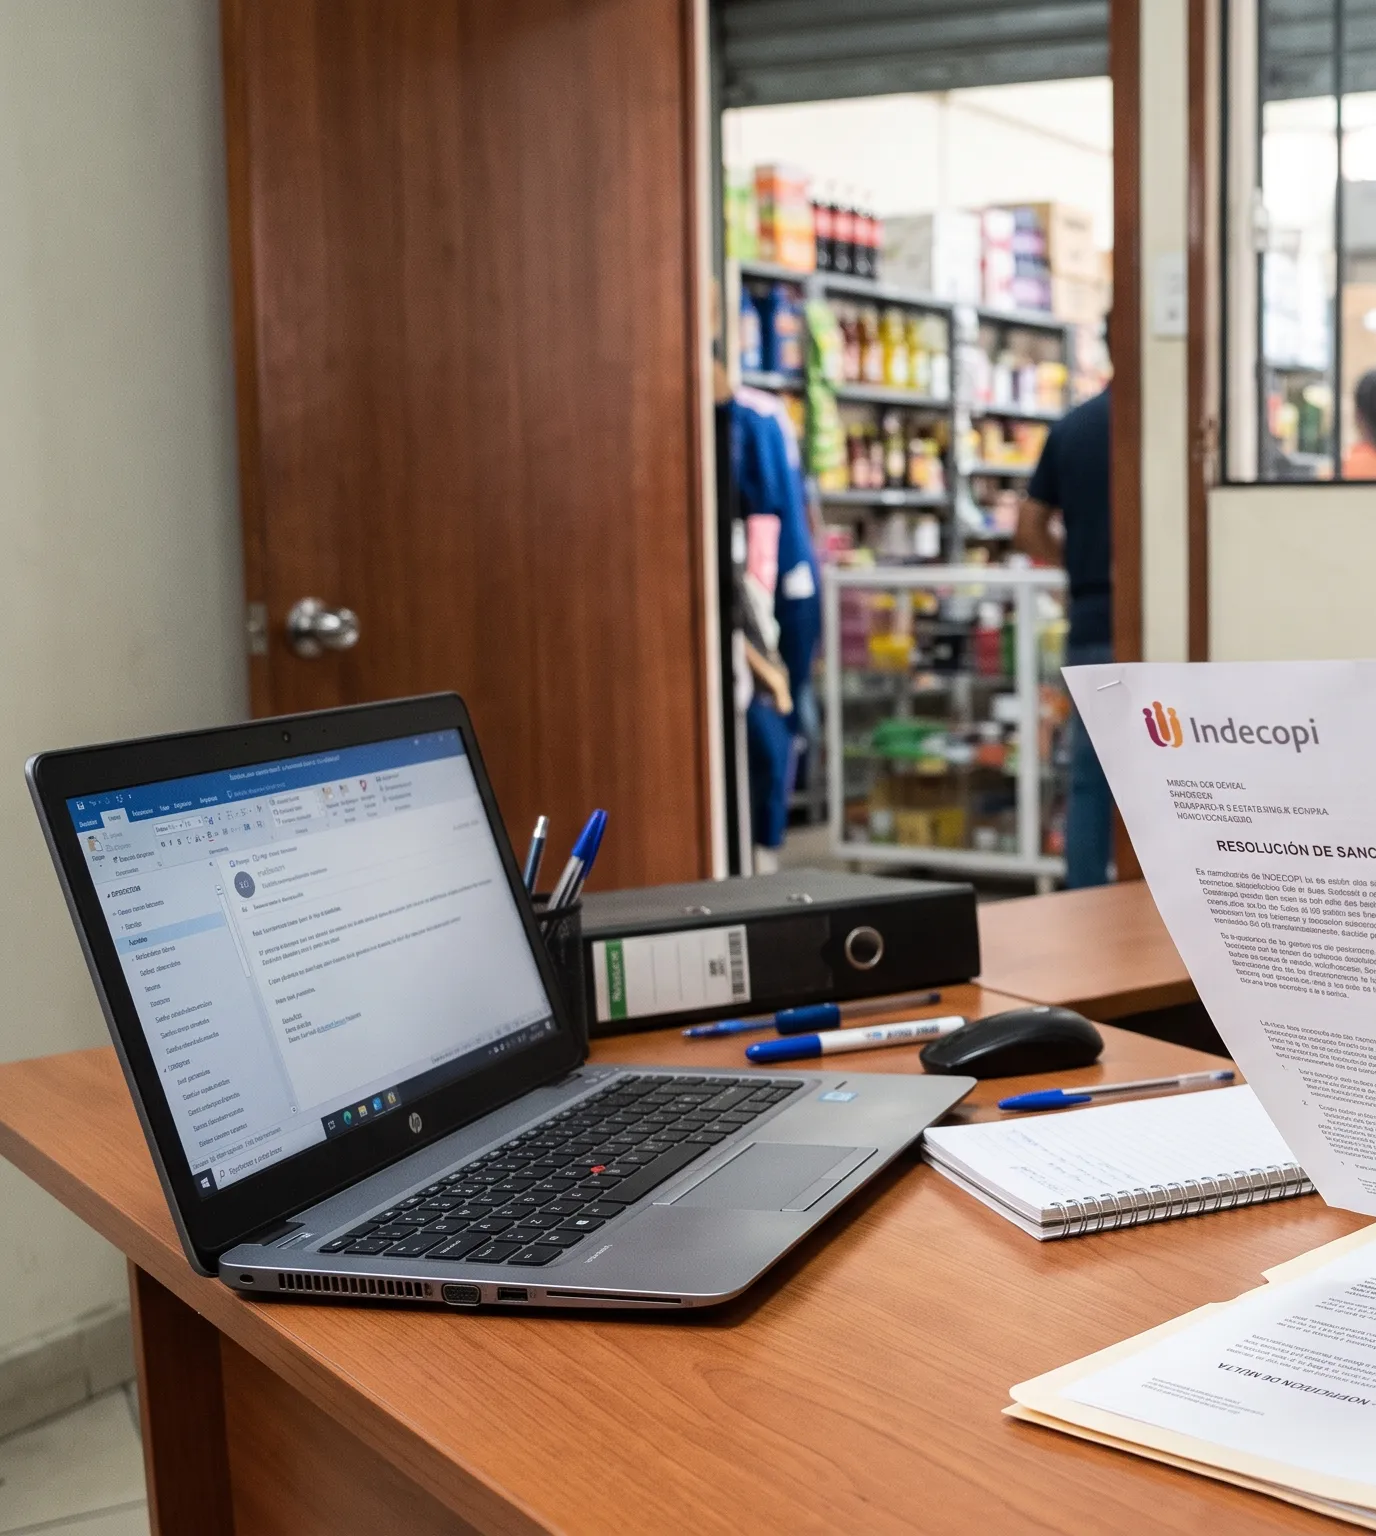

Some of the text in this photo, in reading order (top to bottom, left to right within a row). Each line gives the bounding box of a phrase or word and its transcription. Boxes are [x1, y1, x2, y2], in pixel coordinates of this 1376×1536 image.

[1190, 716, 1320, 753] Indecopi
[1216, 840, 1310, 857] RESOLUCIÓN
[1313, 846, 1334, 858] DE
